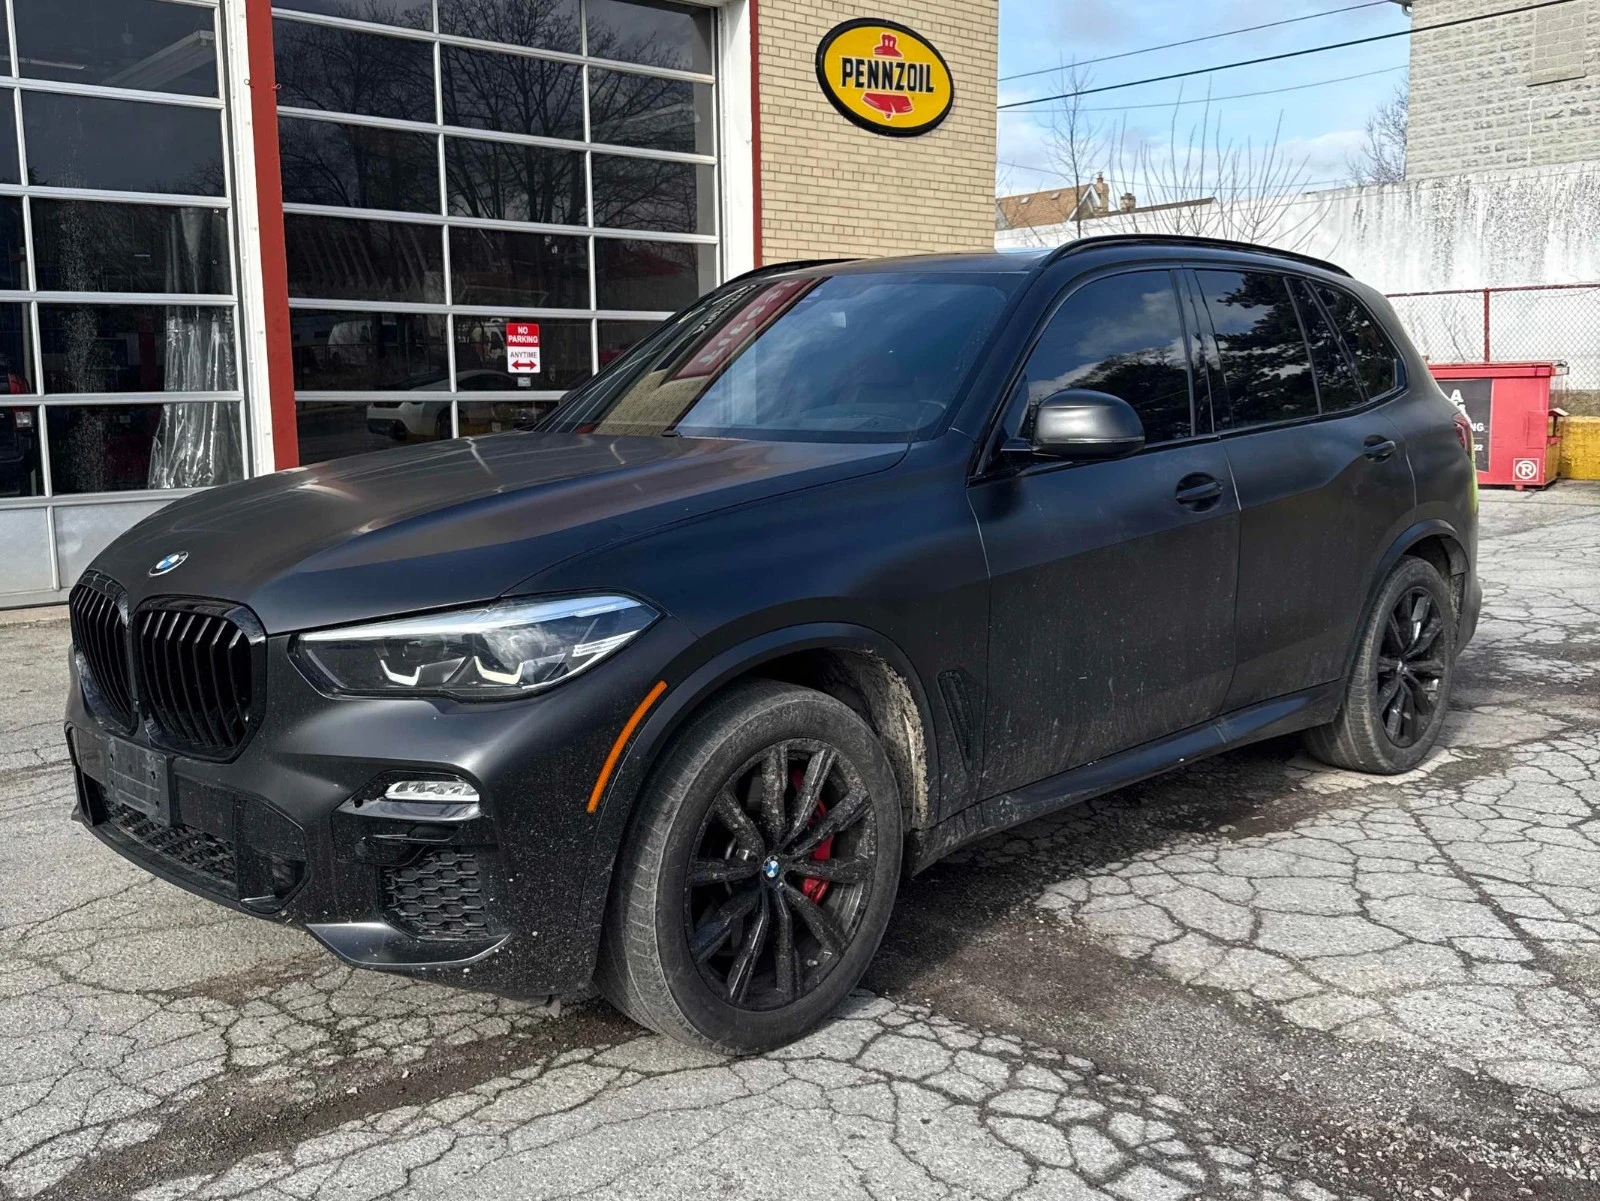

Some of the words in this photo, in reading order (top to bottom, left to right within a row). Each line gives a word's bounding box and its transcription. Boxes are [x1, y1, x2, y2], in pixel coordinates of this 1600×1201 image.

[841, 57, 934, 93] PENNZOIL
[517, 326, 528, 334] NO
[508, 335, 538, 343] PARKING
